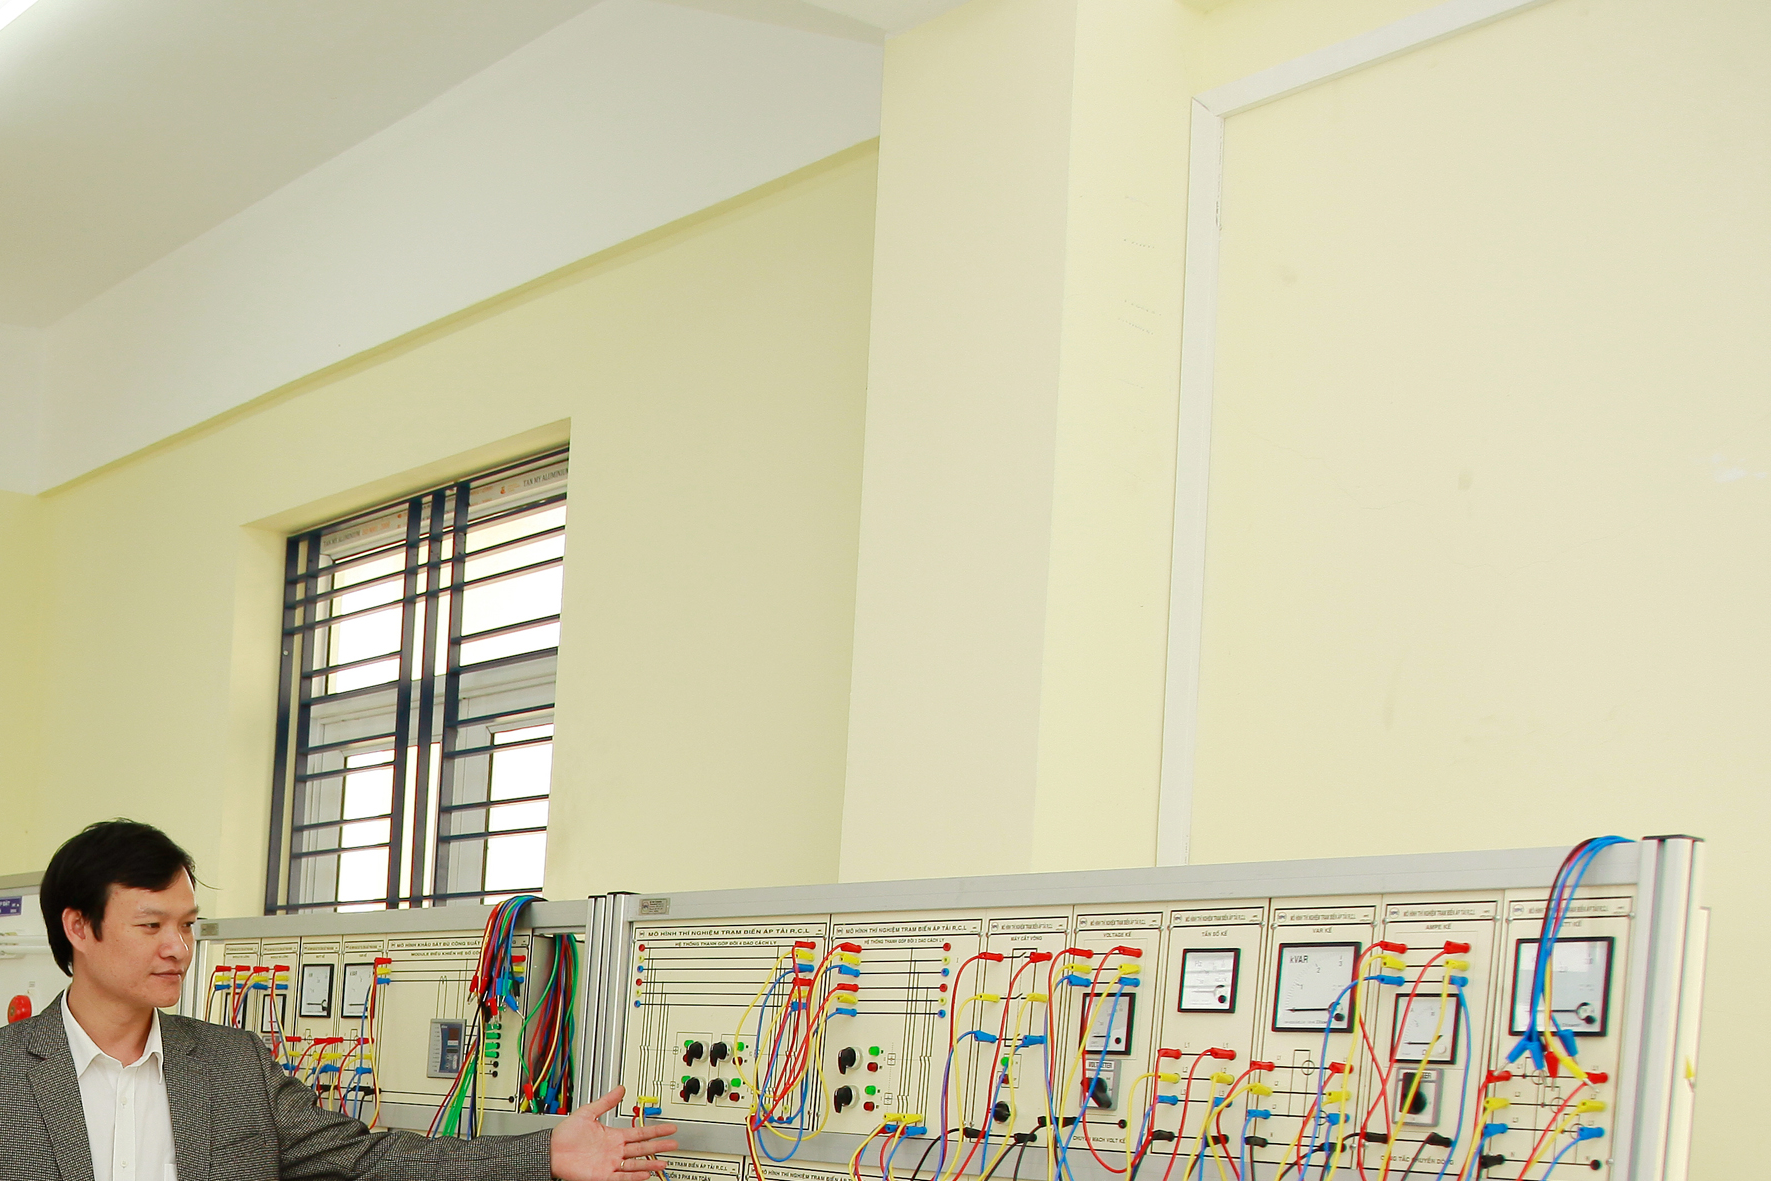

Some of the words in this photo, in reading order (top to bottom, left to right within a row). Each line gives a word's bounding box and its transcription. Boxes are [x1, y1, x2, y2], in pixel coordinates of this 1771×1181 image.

[678, 928, 690, 936] THÍ
[691, 929, 719, 937] NGHIỆM
[855, 926, 868, 934] HÌNH
[879, 926, 900, 934] NGHIỆM
[1290, 955, 1309, 964] kVAR
